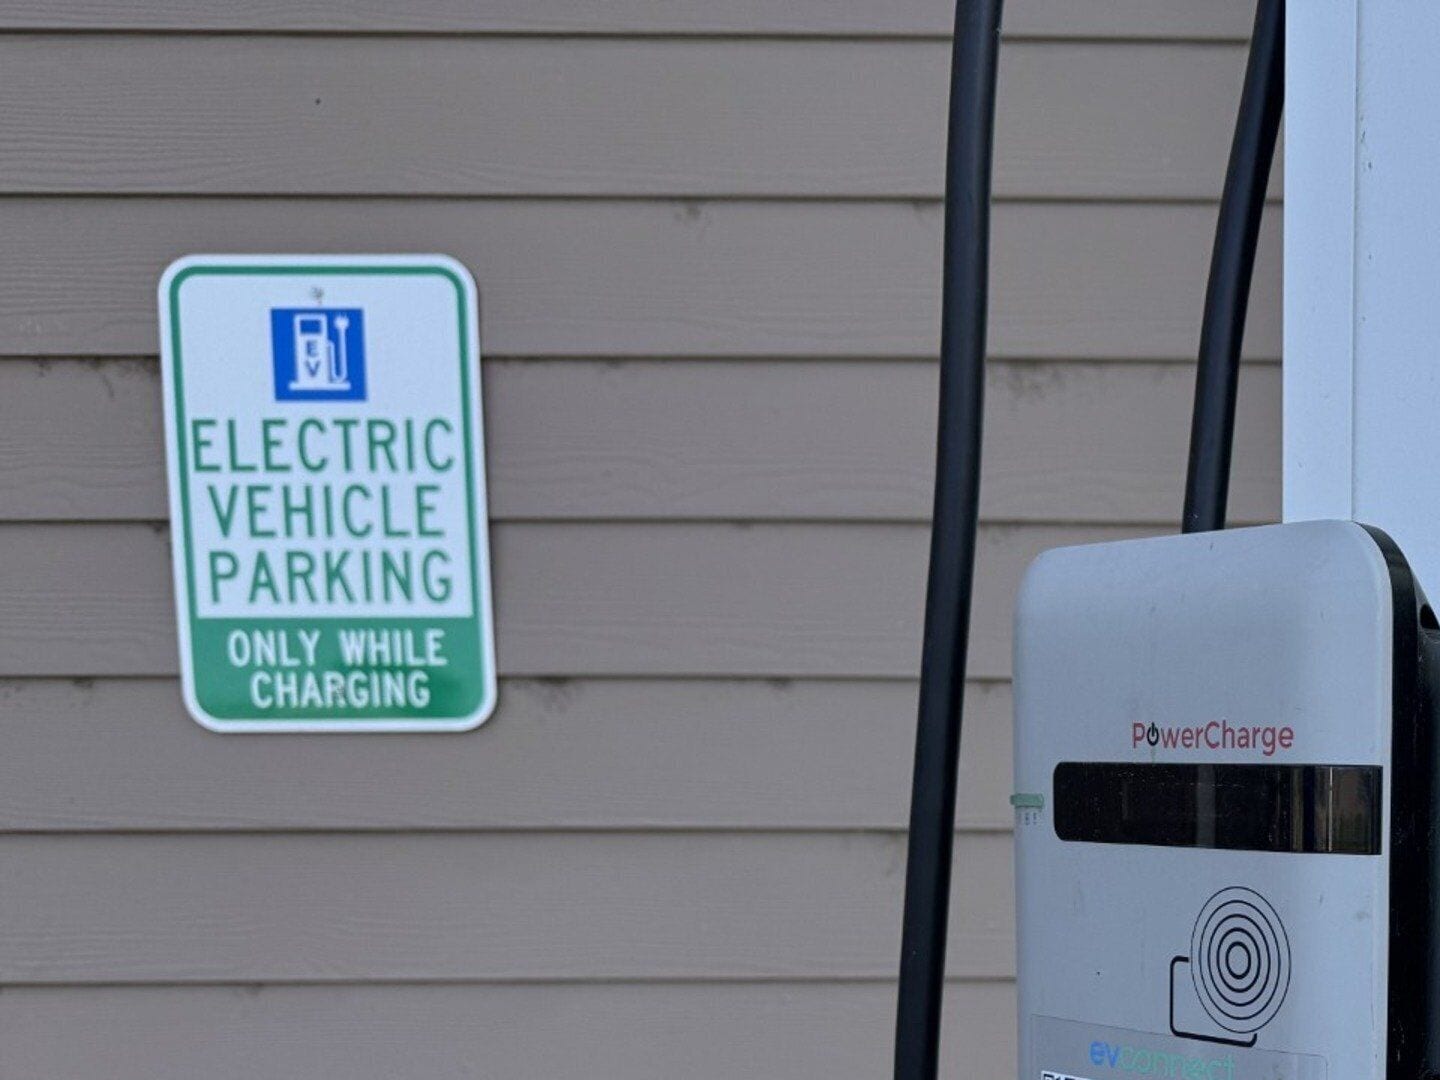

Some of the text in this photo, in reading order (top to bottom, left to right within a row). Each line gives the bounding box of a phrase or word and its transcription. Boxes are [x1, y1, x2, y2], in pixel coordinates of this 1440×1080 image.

[192, 418, 455, 473] ELECTRIC
[208, 484, 446, 538] VEHICLE
[209, 549, 453, 603] PARKING
[228, 629, 447, 668] ONLY WHILE
[250, 671, 430, 709] CHARGING
[1132, 720, 1294, 757] PowerCharge
